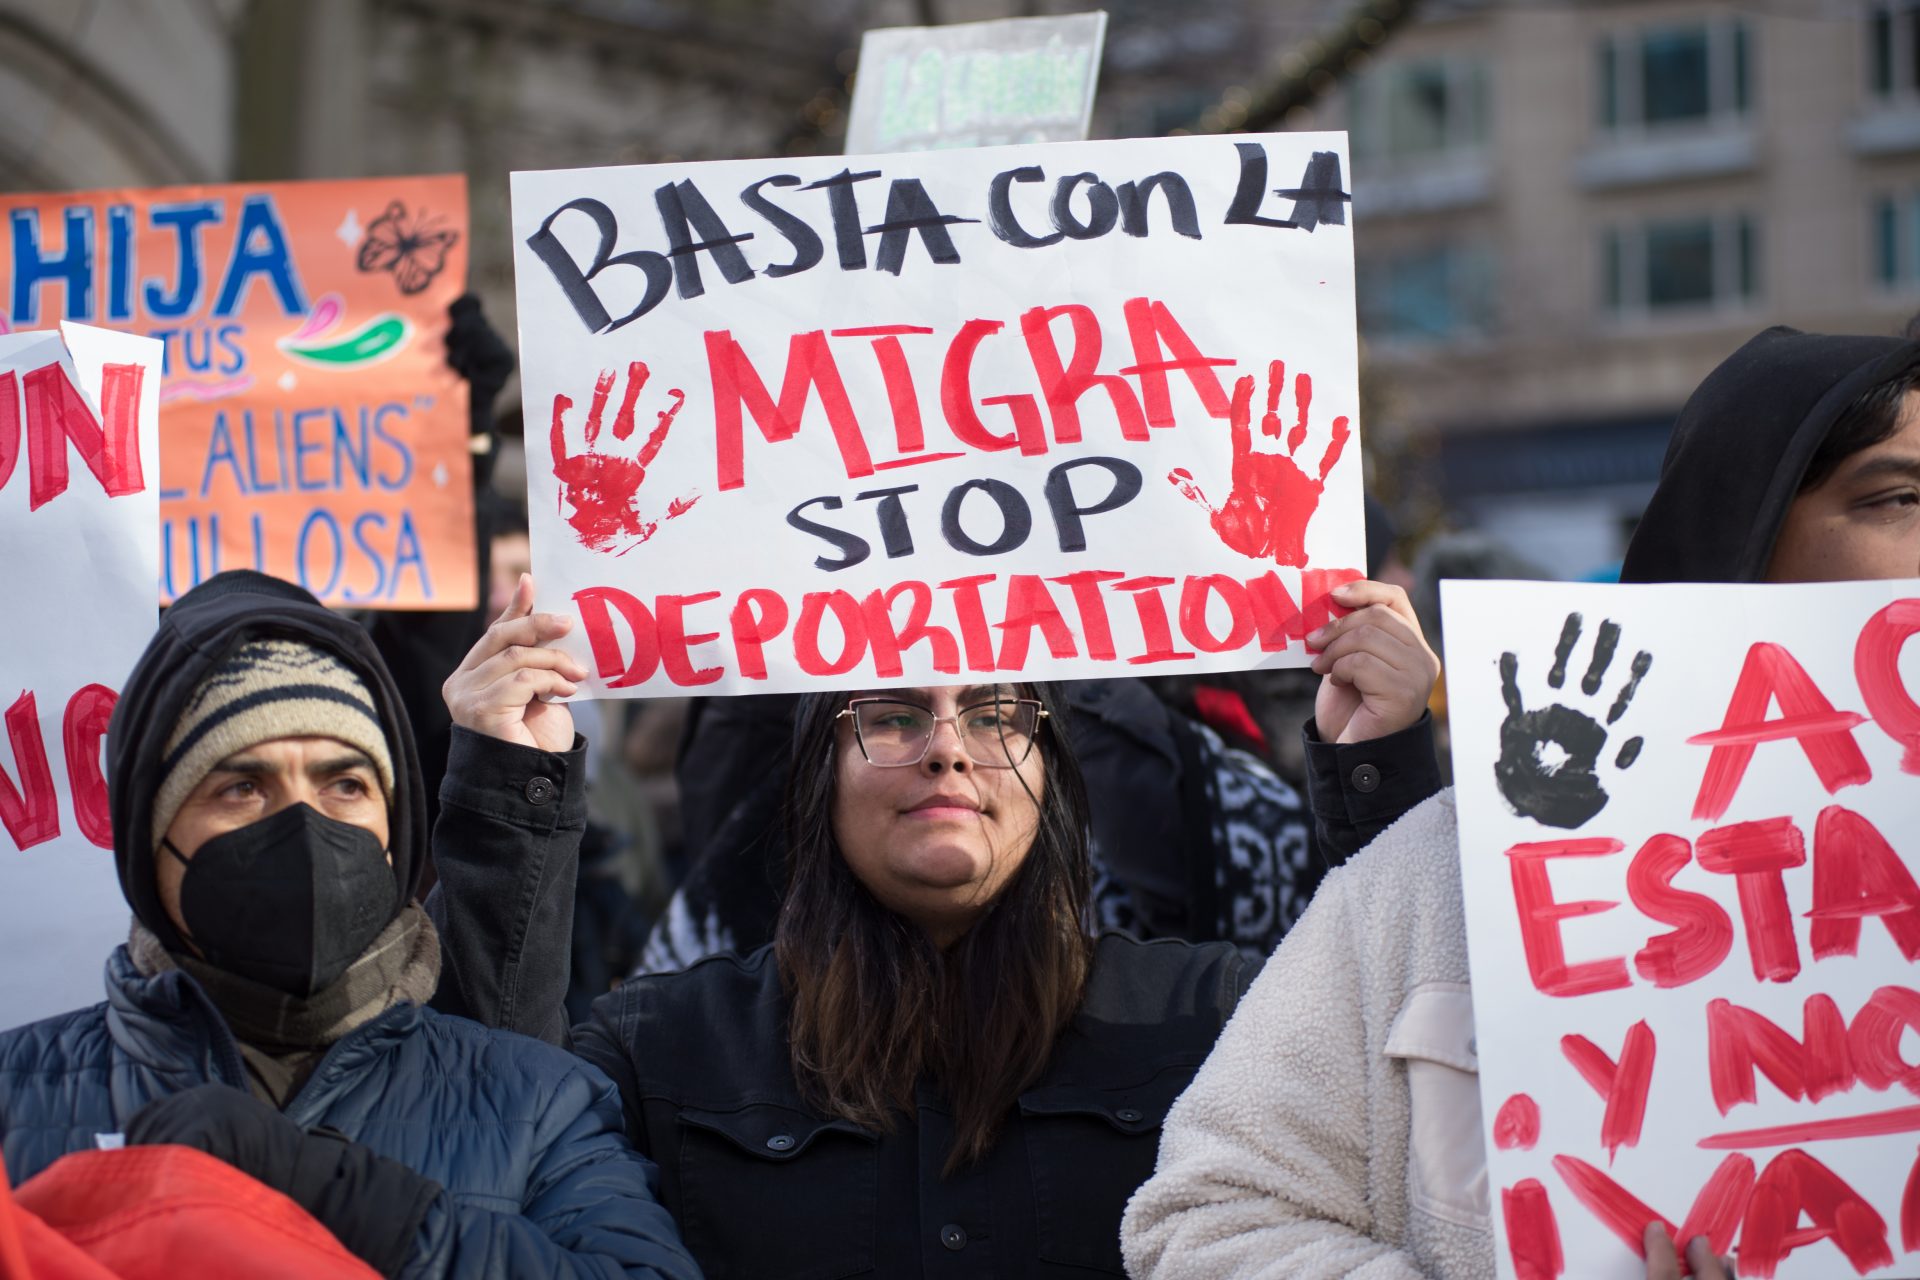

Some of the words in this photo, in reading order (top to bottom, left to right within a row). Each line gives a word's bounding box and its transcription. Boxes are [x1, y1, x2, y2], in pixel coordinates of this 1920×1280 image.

[8, 194, 310, 323] HIJA
[526, 168, 981, 334] BASTA
[1224, 143, 1351, 234] LA
[147, 324, 245, 376] TUS
[704, 297, 1237, 491] MIGRA
[0, 362, 146, 513] N
[787, 456, 1142, 572] STOP
[1504, 804, 1920, 999] ESTA
[1559, 1018, 1656, 1169] Y
